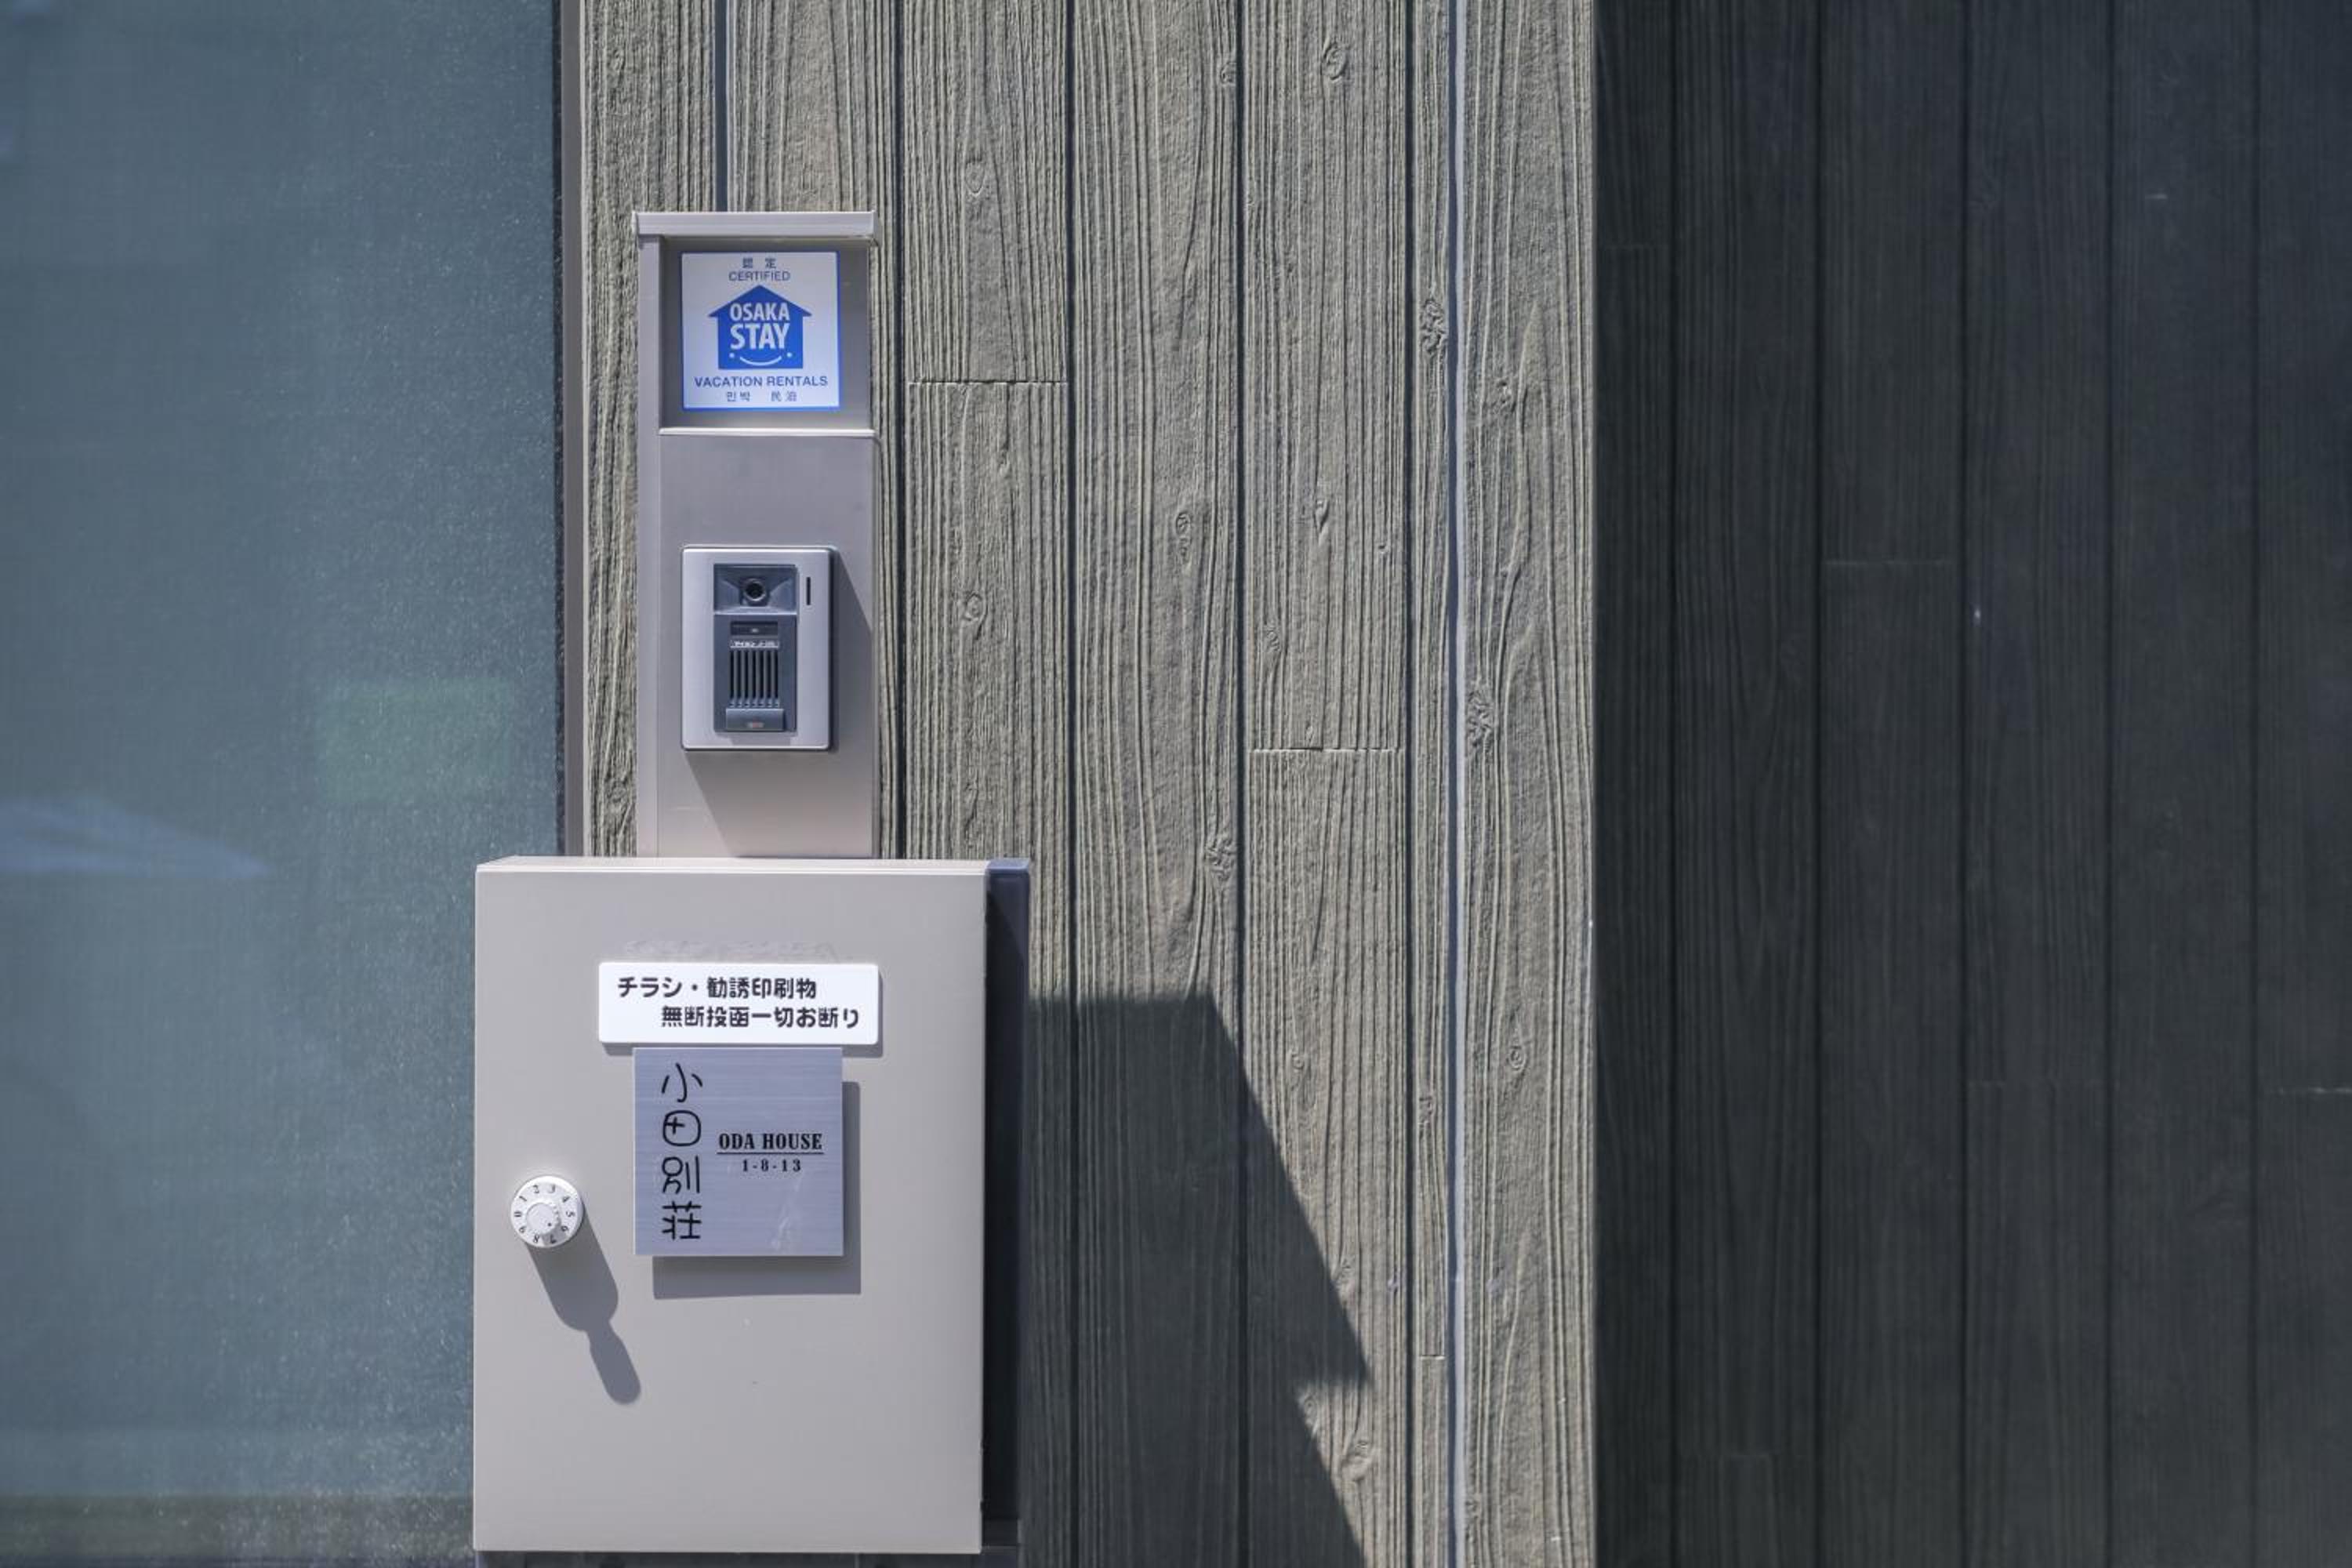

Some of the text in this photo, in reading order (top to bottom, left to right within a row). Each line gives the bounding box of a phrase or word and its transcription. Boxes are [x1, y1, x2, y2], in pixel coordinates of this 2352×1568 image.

[728, 270, 790, 281] CERTIFIED
[729, 303, 790, 321] OSAKA
[730, 323, 790, 350] STAY
[694, 376, 828, 387] VACATION RENTALS
[618, 977, 816, 999] チラシ・勧誘印刷物
[662, 1006, 859, 1029] 無断投函一切お断り
[718, 1133, 822, 1149] ODA HOUSE
[662, 1062, 703, 1240] 小田別荘
[742, 1159, 801, 1172] 1-8-13
